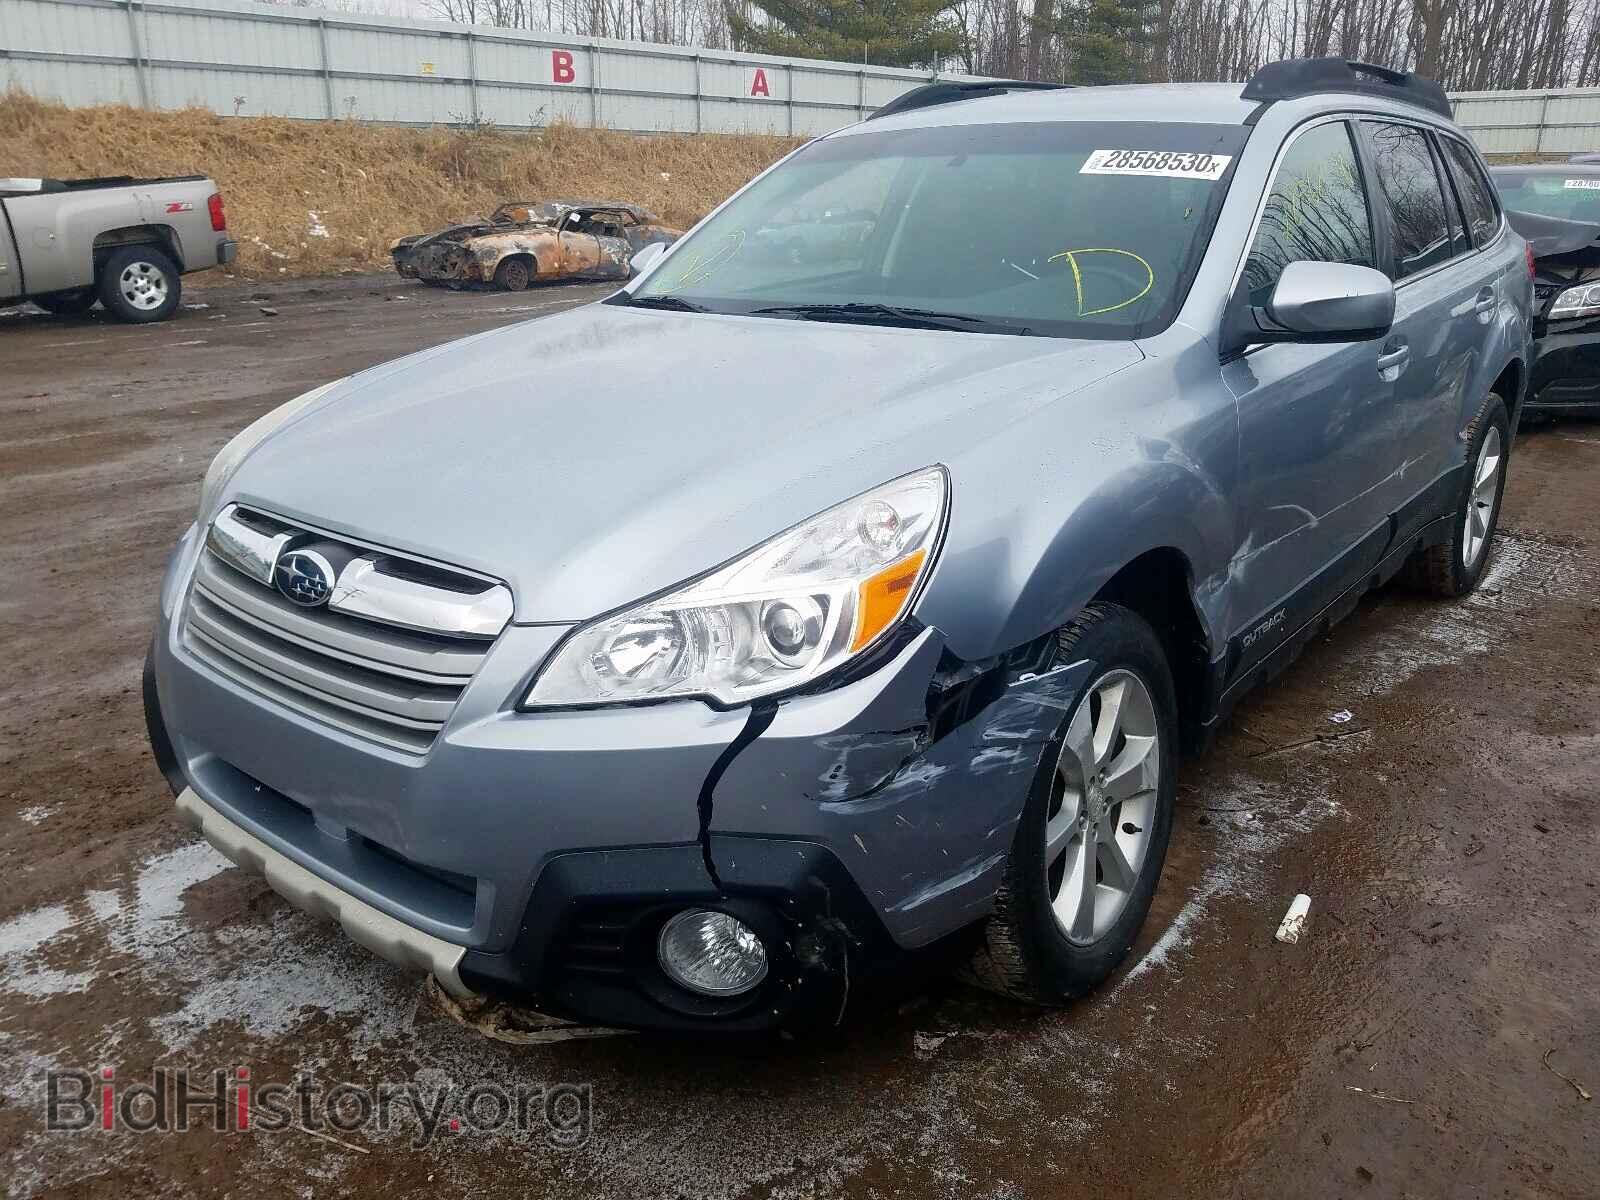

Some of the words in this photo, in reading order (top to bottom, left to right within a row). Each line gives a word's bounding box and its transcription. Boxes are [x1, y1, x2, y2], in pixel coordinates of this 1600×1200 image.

[552, 51, 575, 83] B
[751, 68, 769, 96] A
[1047, 248, 1154, 318] D
[1242, 607, 1287, 648] OUTBACK
